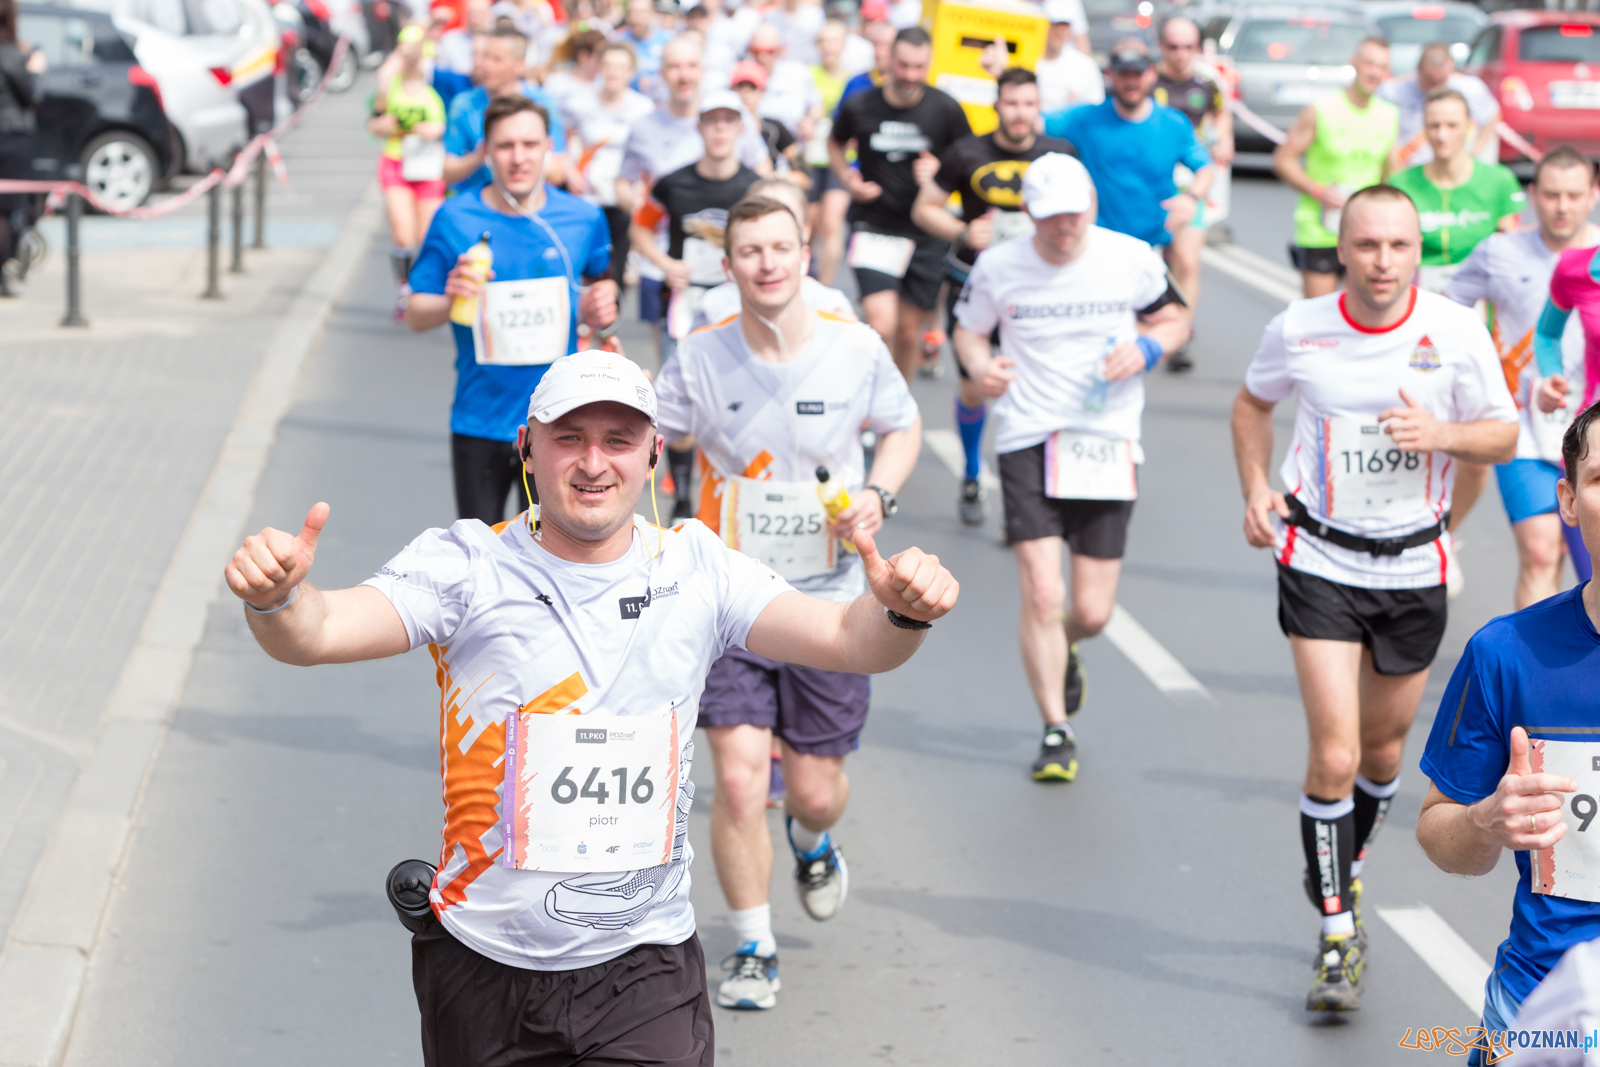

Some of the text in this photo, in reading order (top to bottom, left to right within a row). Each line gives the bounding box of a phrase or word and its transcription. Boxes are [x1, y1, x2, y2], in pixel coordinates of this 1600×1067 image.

[498, 307, 554, 328] 12261
[1072, 441, 1117, 463] 9451
[1341, 450, 1420, 474] 11698
[747, 513, 822, 535] 12225
[551, 766, 654, 805] 6416
[589, 815, 619, 827] piotr
